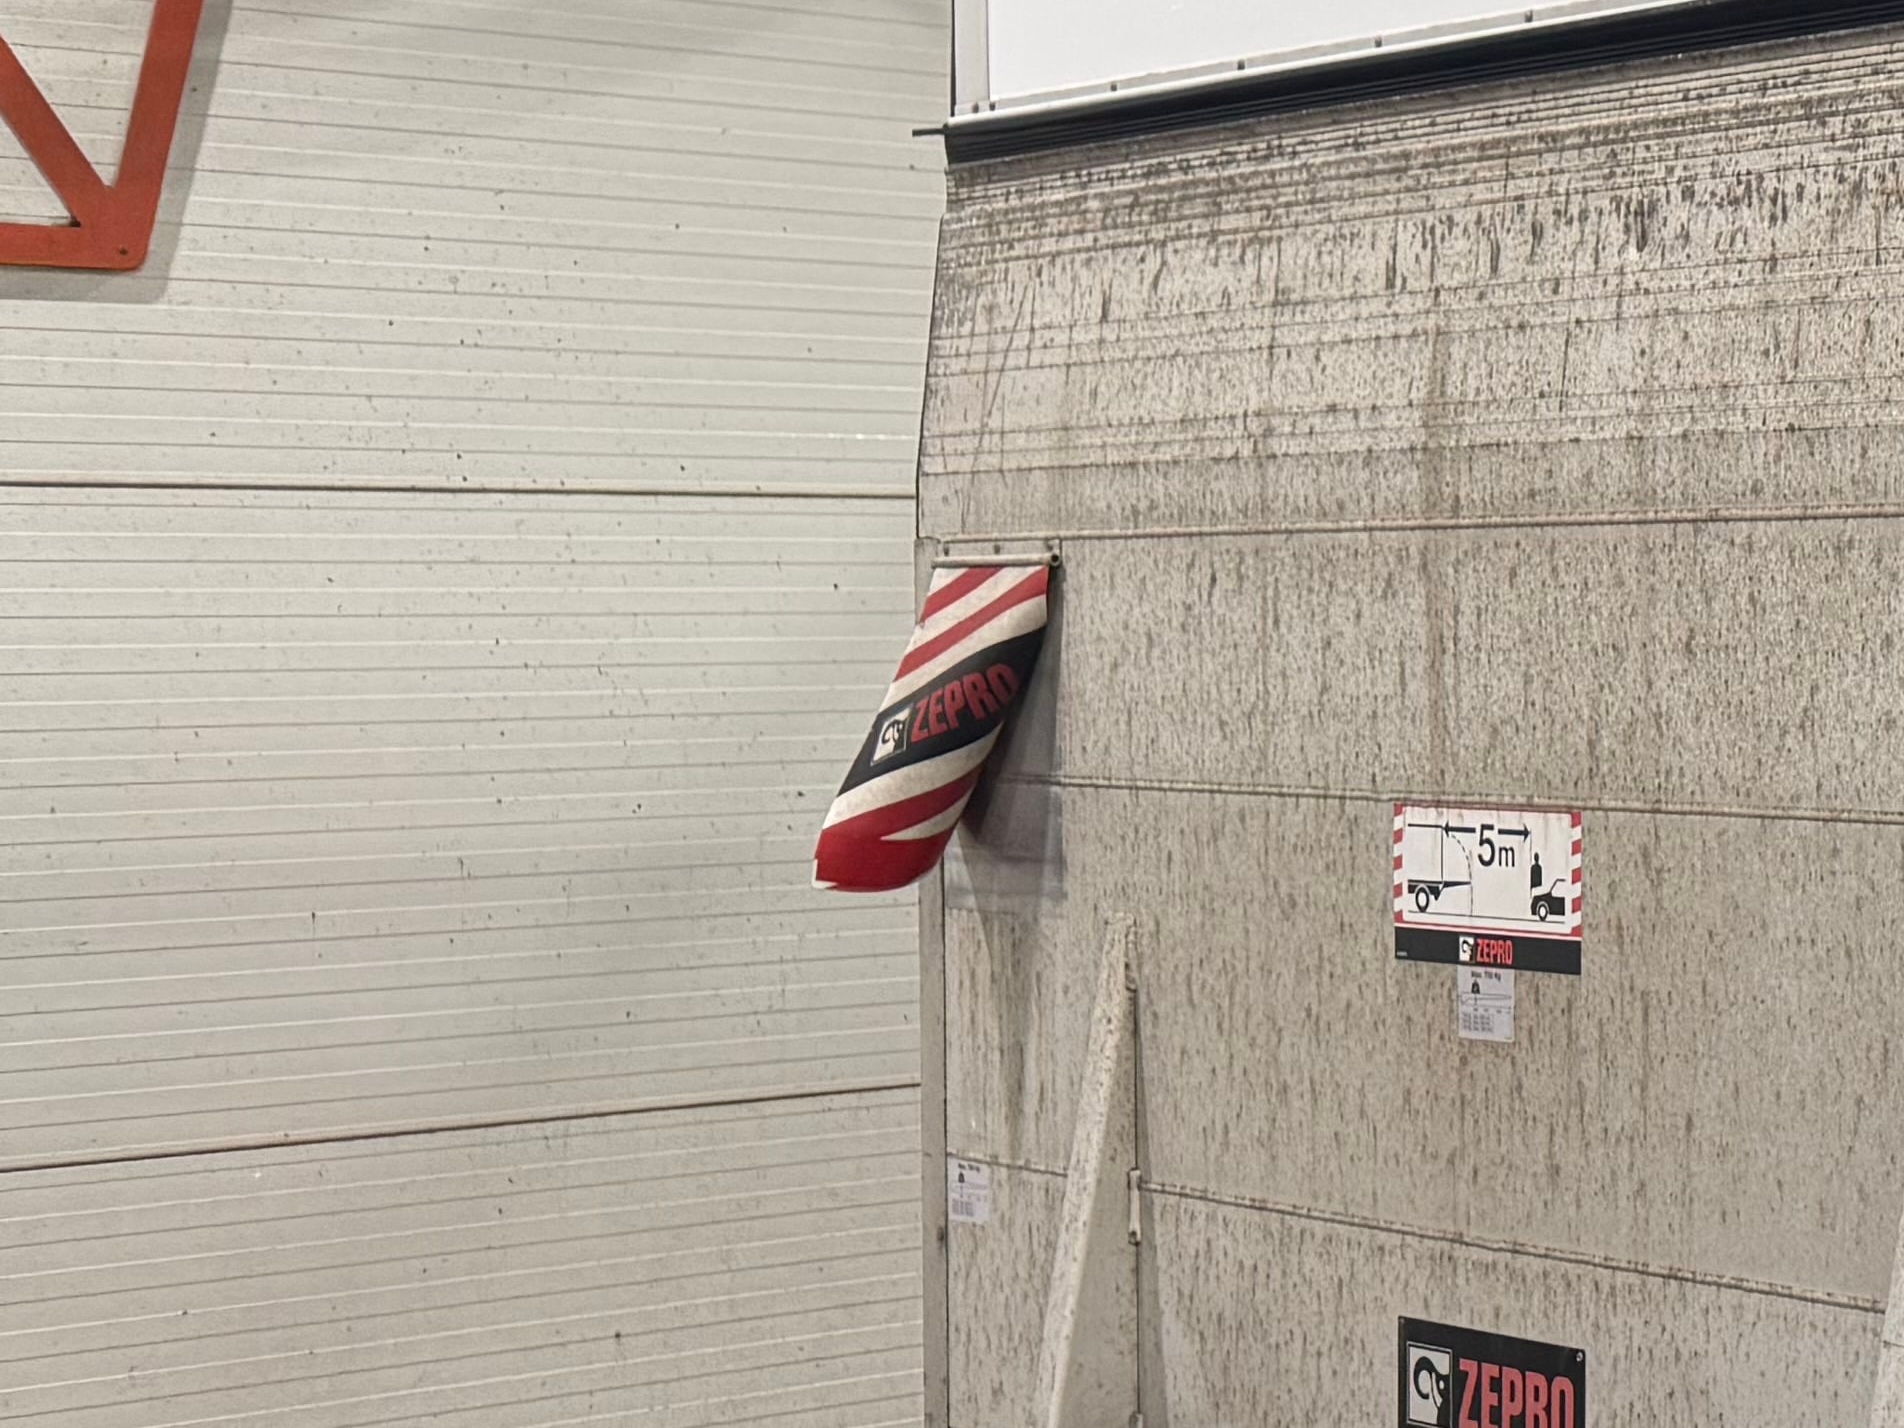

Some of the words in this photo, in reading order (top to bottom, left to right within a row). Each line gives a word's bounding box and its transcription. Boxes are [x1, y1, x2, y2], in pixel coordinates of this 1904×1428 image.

[911, 663, 1019, 743] ZEPRO
[1477, 824, 1495, 868] 5
[1498, 844, 1516, 868] m
[1476, 939, 1513, 965] ZEPRO
